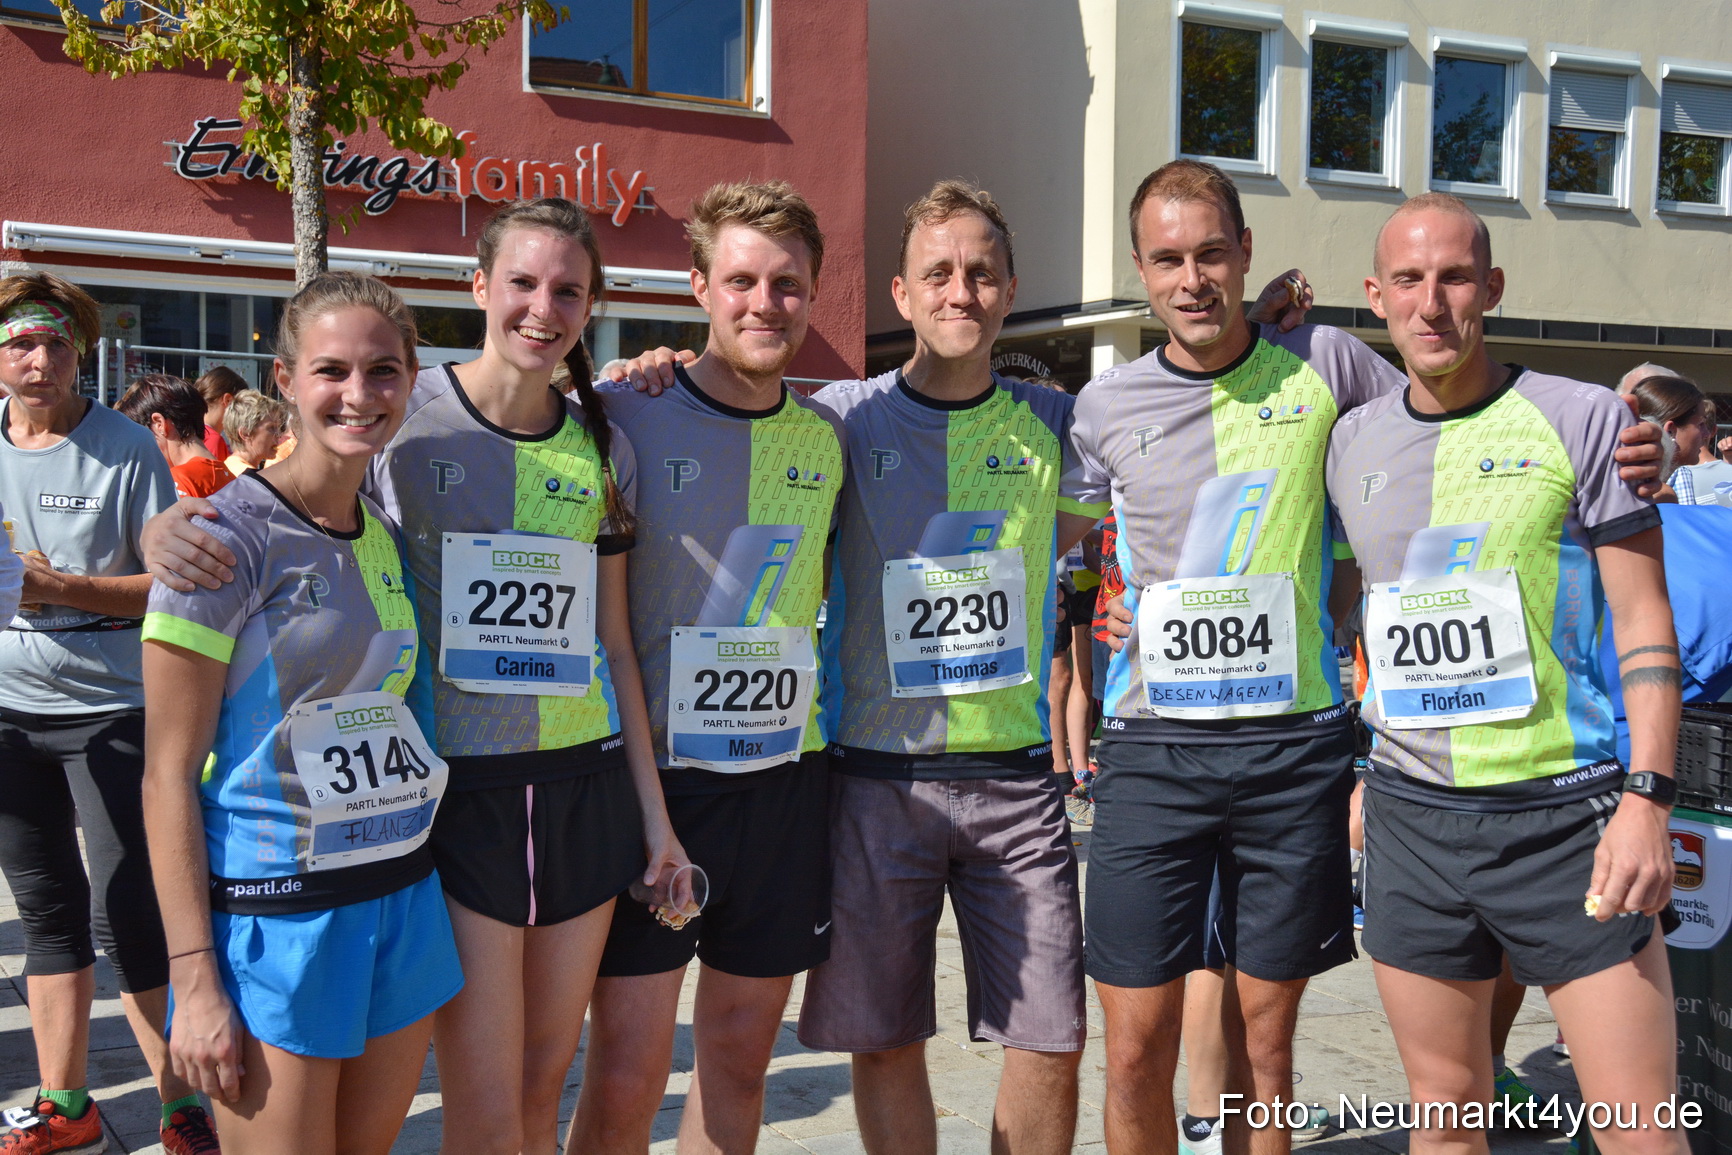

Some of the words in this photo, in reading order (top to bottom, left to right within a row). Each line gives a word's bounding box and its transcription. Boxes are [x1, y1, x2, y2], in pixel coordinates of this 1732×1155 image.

[452, 130, 647, 227] family
[40, 494, 101, 510] BOCK
[492, 550, 560, 570] BOCK
[925, 566, 990, 586] BOCK
[468, 580, 576, 630] 2237
[1182, 588, 1250, 606] BOCK
[1400, 588, 1471, 612] BOCK
[1564, 568, 1582, 628] BORN
[907, 590, 1008, 640] 2230
[1402, 608, 1422, 617] inspired
[1448, 604, 1473, 612] concepts
[452, 615, 458, 624] B
[479, 634, 512, 645] PARTL
[516, 636, 558, 647] Neumarkt
[894, 633, 900, 641] B
[1163, 614, 1273, 661] 3084
[1387, 616, 1495, 667] 2001
[718, 642, 780, 656] BOCK
[920, 644, 951, 654] PARTL
[954, 640, 994, 651] Neumarkt
[1149, 653, 1154, 661] D
[1380, 659, 1386, 668] D
[495, 656, 556, 678] Carina
[930, 661, 998, 680] Thomas
[1174, 666, 1206, 676] PARTL
[1208, 664, 1253, 674] Neumarkt
[1405, 674, 1434, 682] PARTL
[1436, 669, 1482, 682] Neumarkt
[694, 668, 798, 712] 2220
[678, 702, 684, 711] B
[1422, 691, 1486, 712] Florian
[335, 706, 396, 730] BOCK
[703, 719, 735, 728] PARTL
[737, 719, 776, 728] Neumarkt
[339, 726, 360, 736] inspired
[729, 740, 764, 757] Max
[323, 736, 430, 794] 3140
[316, 789, 324, 798] D
[346, 799, 376, 813] PARTL
[378, 791, 418, 808] Neumarkt
[1670, 898, 1709, 912] markter
